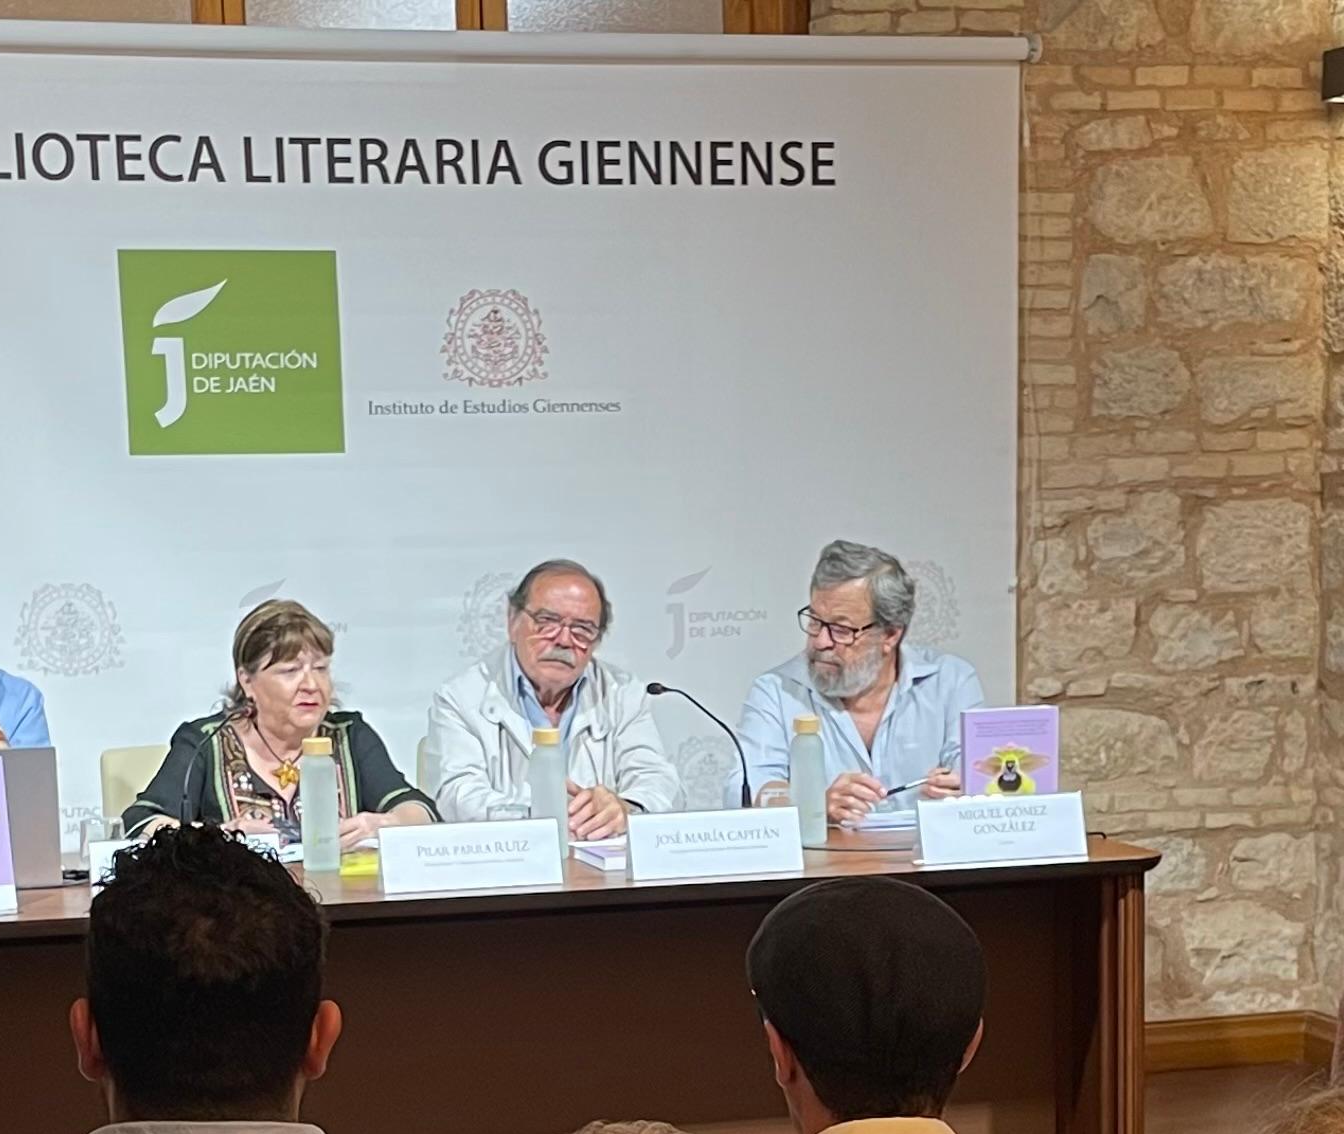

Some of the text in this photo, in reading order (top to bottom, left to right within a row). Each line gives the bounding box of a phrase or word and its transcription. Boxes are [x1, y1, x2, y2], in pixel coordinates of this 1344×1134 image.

[243, 135, 523, 186] LITERARIA
[537, 138, 837, 187] GIENNENSE
[190, 348, 318, 370] DIPUTACIÓN
[192, 372, 277, 394] DE JAÉN
[367, 397, 622, 416] Instituto de Estudios Giennenses
[688, 608, 768, 623] DIPUTACIÓN
[688, 626, 705, 638] DE
[957, 808, 1002, 821] MIGUEL
[655, 828, 682, 848] JOSÉ
[416, 844, 450, 857] PILAR
[494, 839, 530, 853] RUIZ
